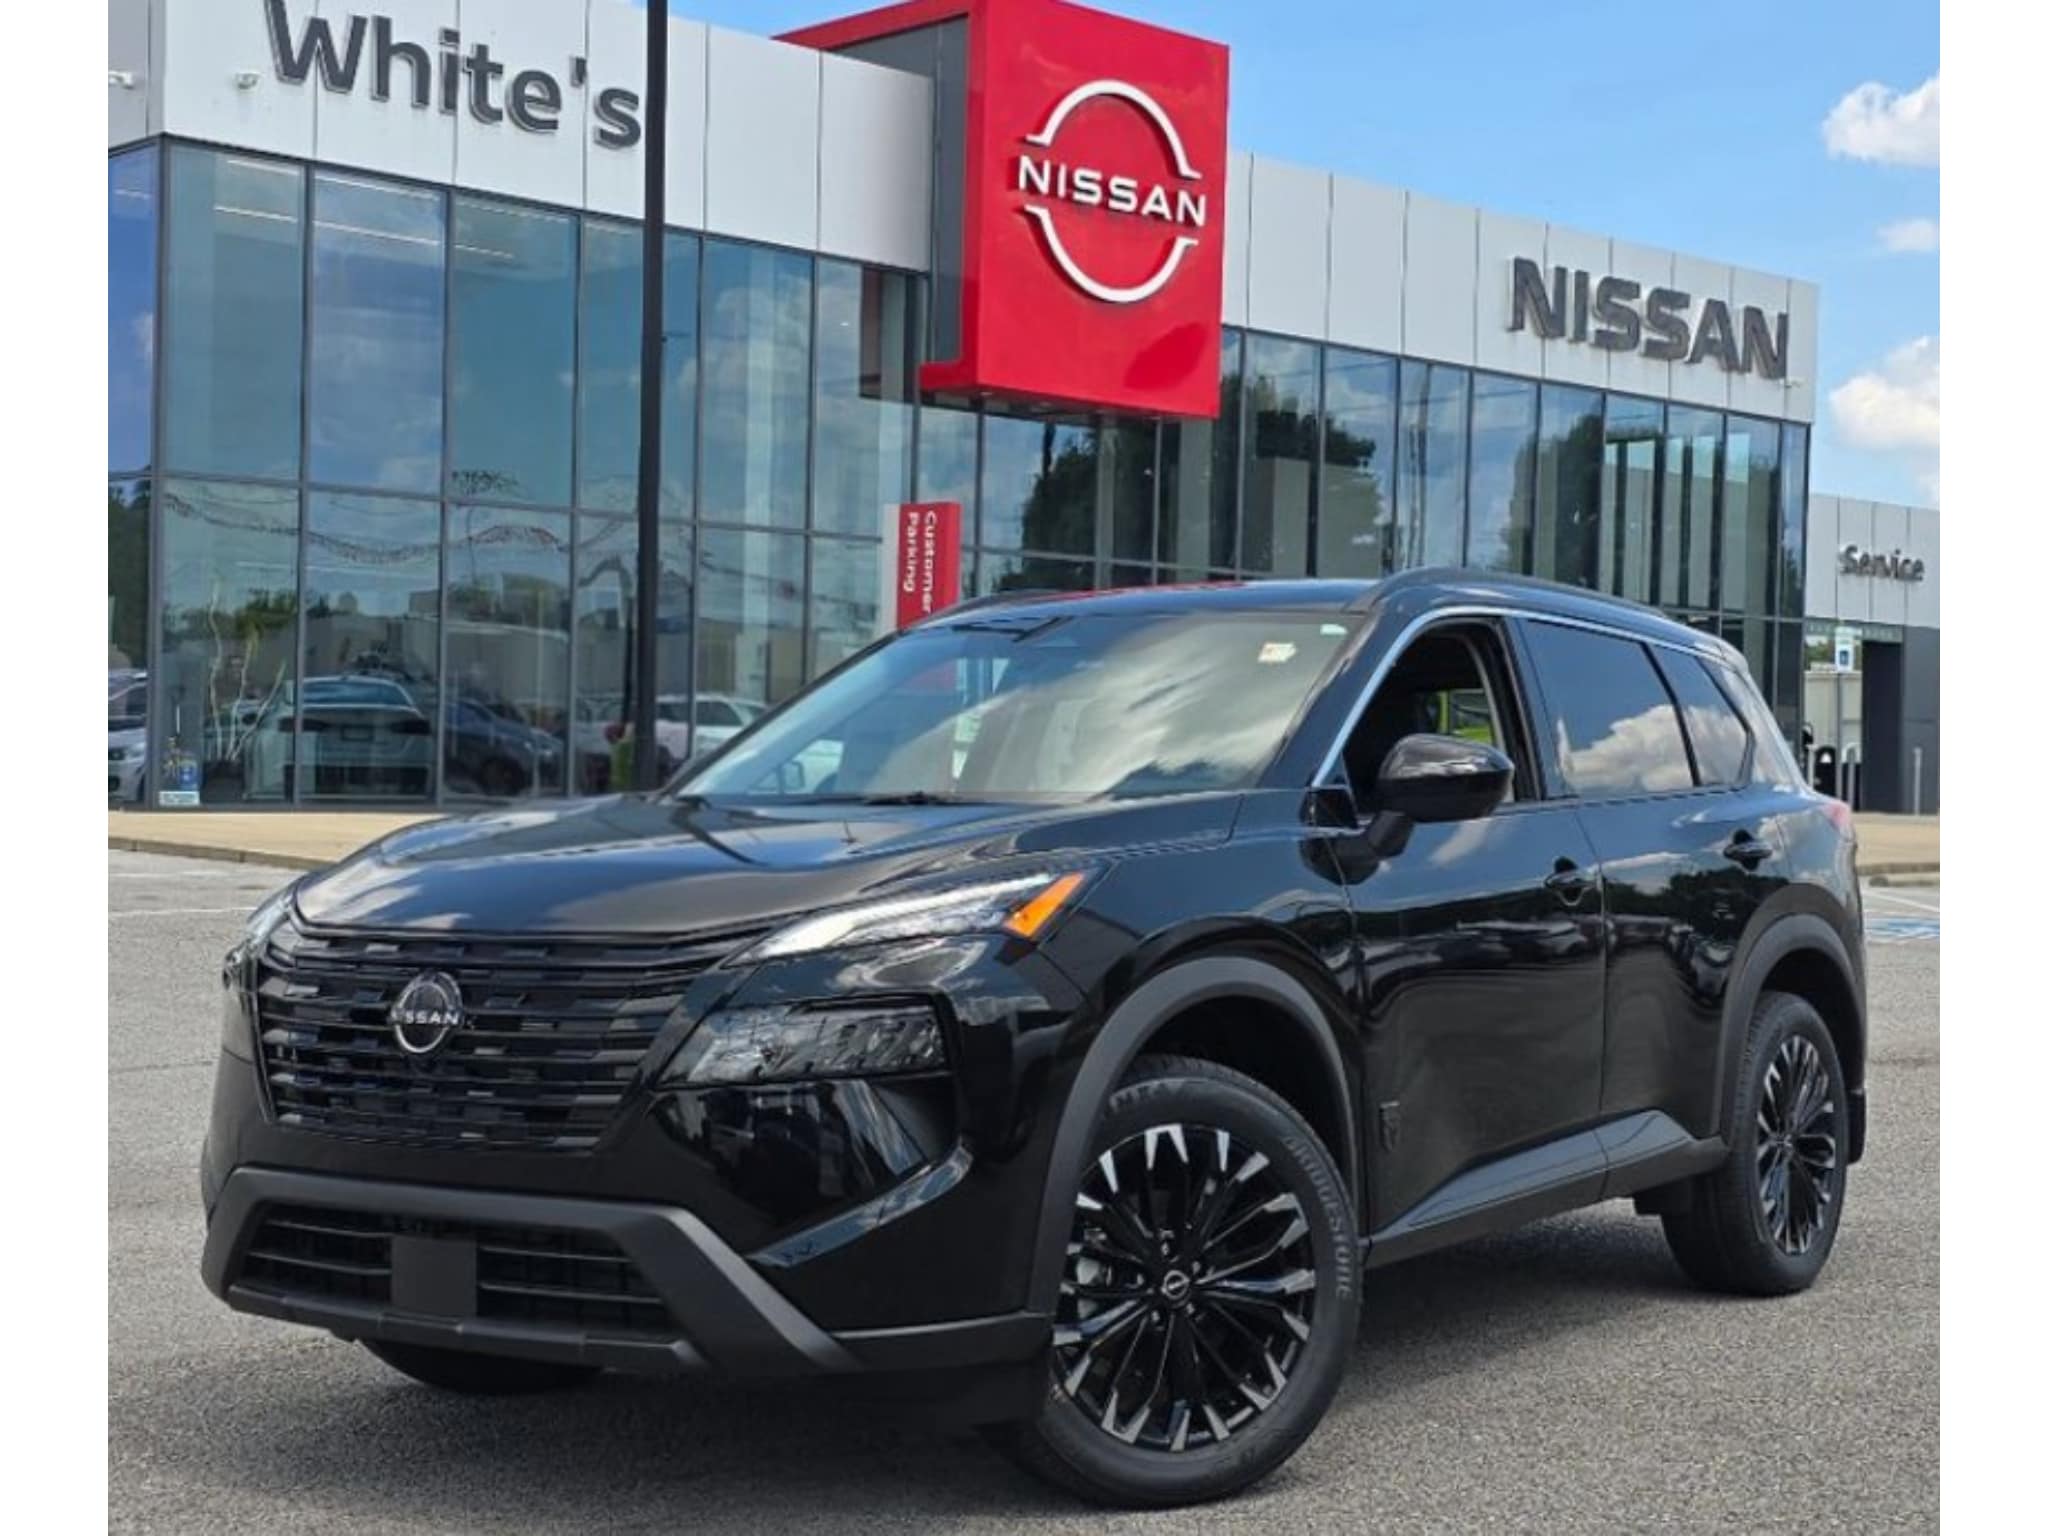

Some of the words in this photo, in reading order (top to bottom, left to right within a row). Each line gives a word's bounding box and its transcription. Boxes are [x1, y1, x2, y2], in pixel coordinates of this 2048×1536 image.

[265, 0, 643, 149] White's
[1018, 155, 1206, 227] NISSAN
[1508, 256, 1789, 379] NISSAN
[903, 512, 919, 593] Parking
[922, 510, 937, 613] Customer
[1839, 545, 1925, 582] Service
